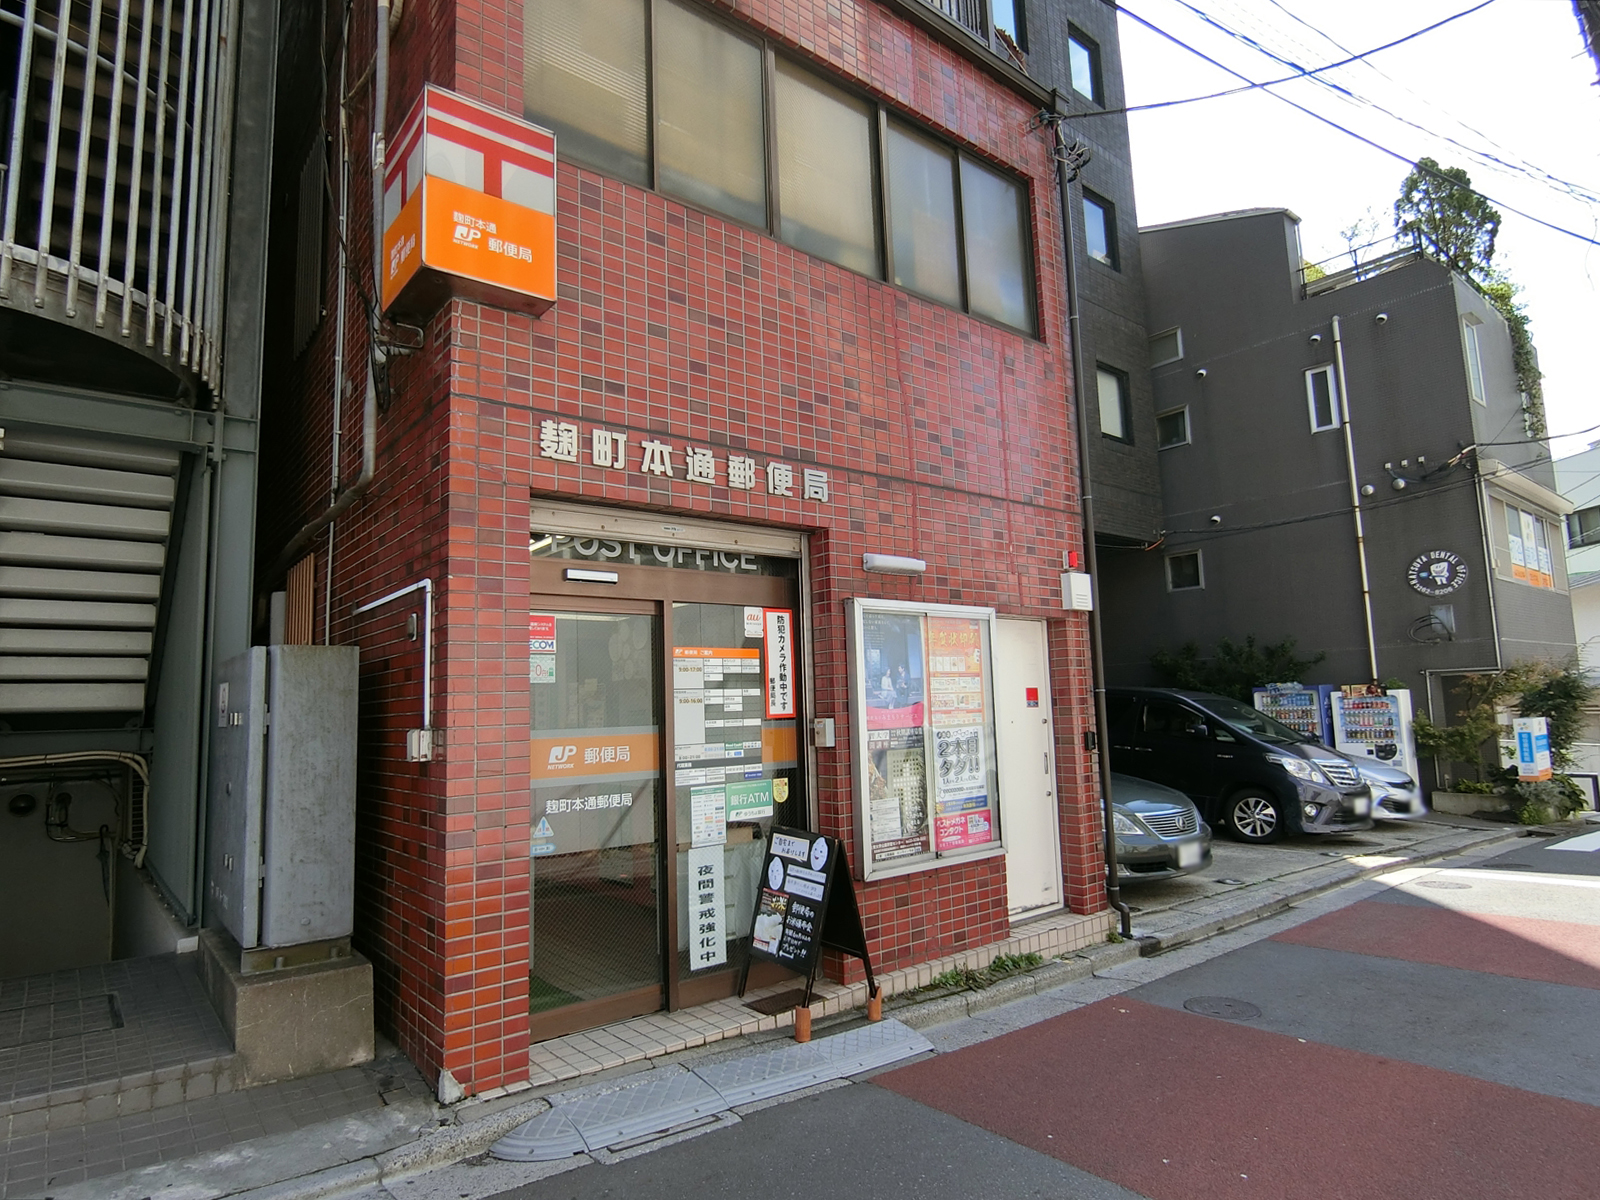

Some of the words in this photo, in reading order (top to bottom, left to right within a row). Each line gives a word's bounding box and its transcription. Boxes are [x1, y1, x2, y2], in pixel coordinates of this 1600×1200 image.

[452, 211, 497, 234] 麹町本通
[488, 237, 533, 263] 郵便局
[539, 419, 829, 503] 麹町本通郵便局
[1430, 551, 1459, 564] DENTAL
[1451, 564, 1466, 588] OFFICE
[746, 613, 761, 621] au
[776, 615, 788, 711] 防犯カメラ作動中です
[584, 746, 630, 764] 郵便局
[937, 737, 979, 758] 2本目
[545, 793, 633, 814] 麹町本通郵便局
[730, 792, 769, 806] 銀行ATM
[697, 864, 716, 962] 夜間警戒強化中
